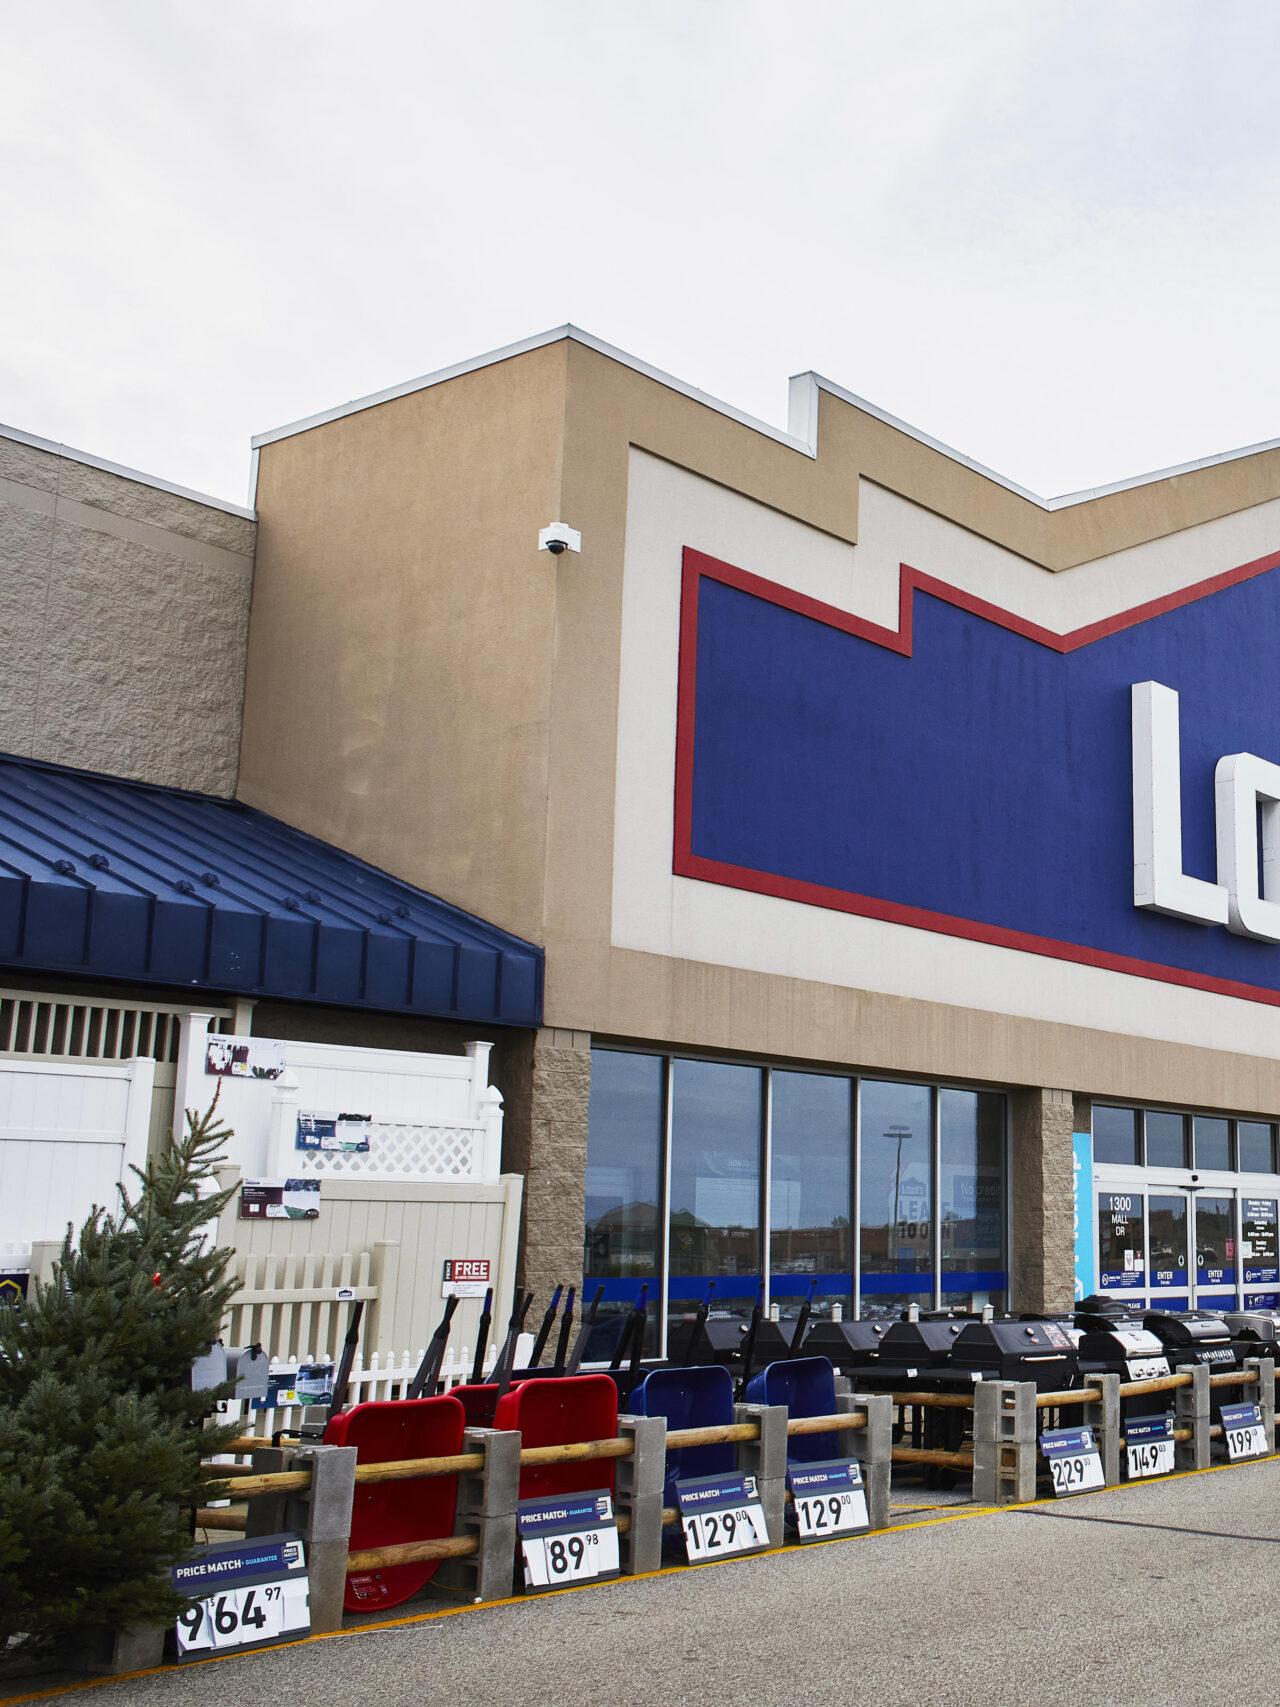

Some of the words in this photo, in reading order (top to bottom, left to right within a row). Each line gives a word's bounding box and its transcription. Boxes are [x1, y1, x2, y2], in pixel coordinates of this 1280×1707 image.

[961, 1181, 975, 1195] No
[899, 1200, 950, 1220] LEAE
[1109, 1196, 1132, 1211] 1300
[1111, 1214, 1129, 1224] MALL
[898, 1222, 917, 1240] TO
[1116, 1226, 1126, 1236] DR
[455, 1262, 488, 1276] FREE
[1156, 1272, 1174, 1280] ENTER
[1208, 1270, 1224, 1278] ENTER
[1230, 1430, 1252, 1453] 199
[792, 1476, 809, 1485] PRICE
[809, 1474, 828, 1483] MATCH
[681, 1493, 699, 1502] PRICE
[699, 1489, 720, 1499] MATCH
[521, 1513, 542, 1524] PRICE
[543, 1510, 567, 1520] MATCH
[176, 1565, 206, 1578] PRICE
[208, 1559, 242, 1573] MATCH
[245, 1555, 278, 1565] GUARANTEE
